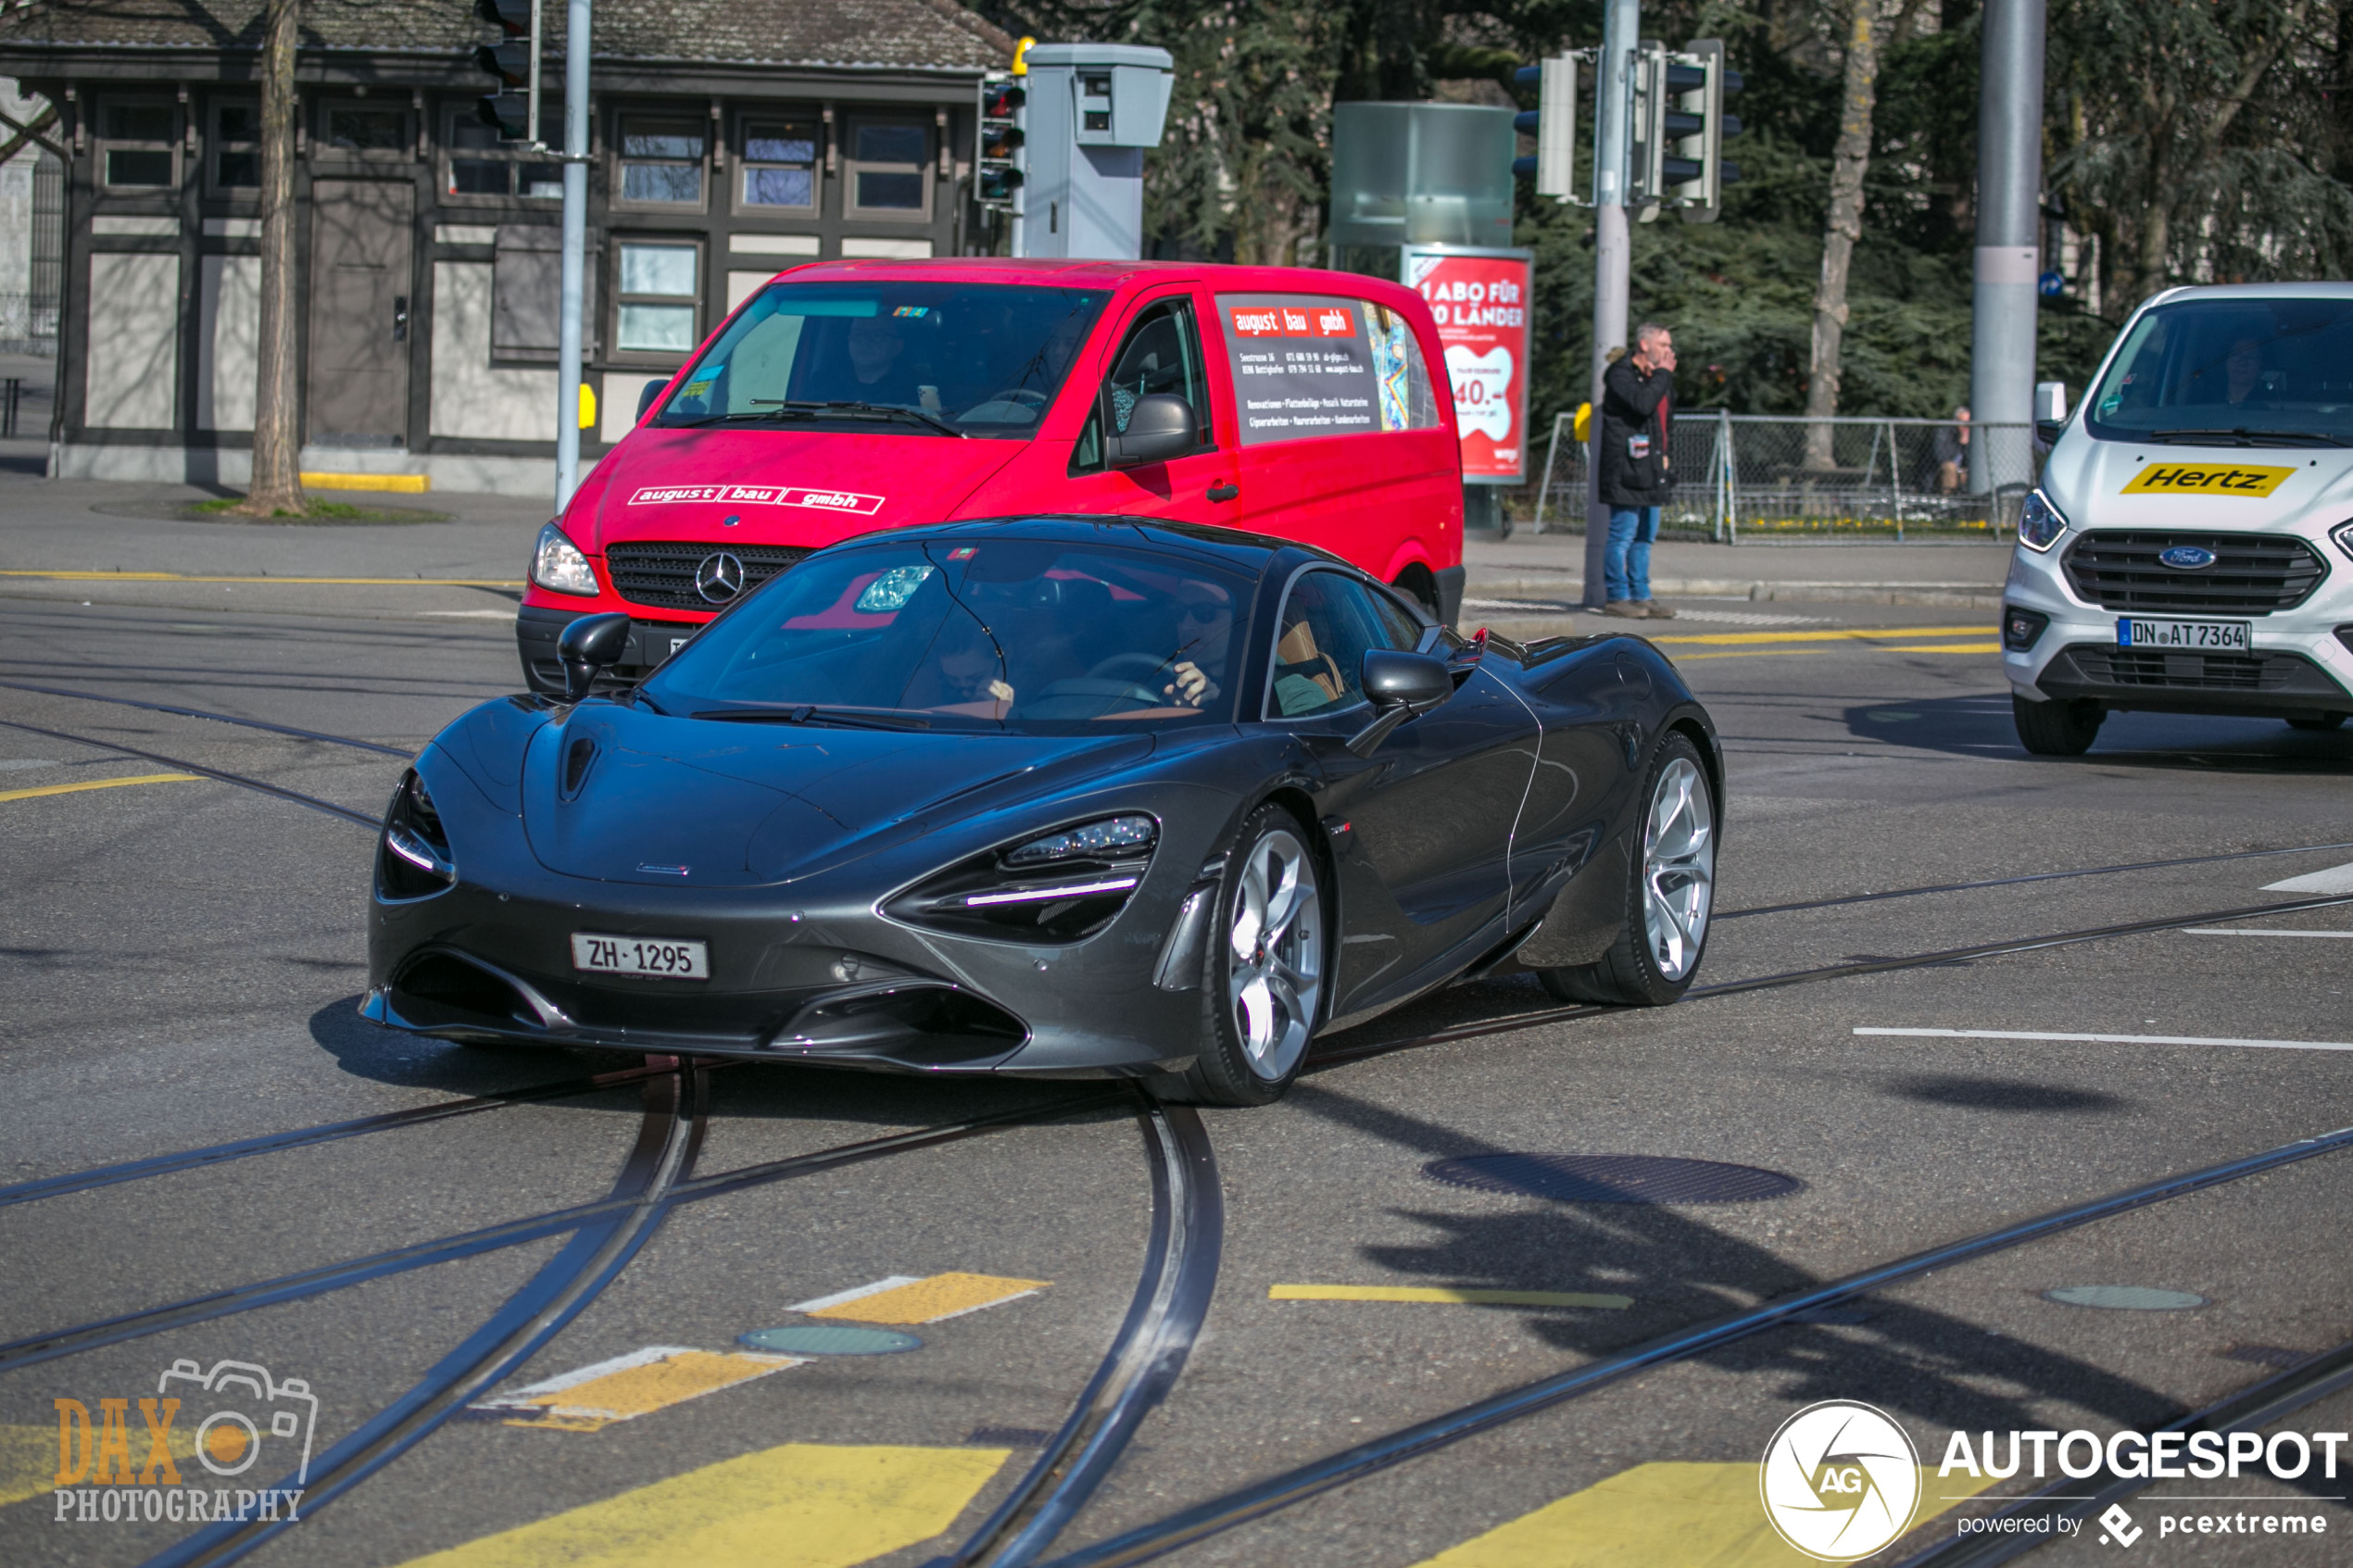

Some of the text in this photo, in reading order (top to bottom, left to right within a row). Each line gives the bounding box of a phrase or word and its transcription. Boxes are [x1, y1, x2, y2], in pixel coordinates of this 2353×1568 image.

[1420, 279, 1520, 304] 1 ABO FÜR
[1235, 308, 1347, 336] august bau gmbh
[1430, 302, 1525, 328] 0 LÄNDER
[1239, 353, 1267, 362] Seestrasse
[1247, 398, 1282, 410] Renovationen
[2143, 469, 2269, 490] Hertz
[639, 487, 859, 508] august bau gmbh
[2171, 549, 2202, 565] Ford
[2132, 622, 2245, 647] DN AT 7364
